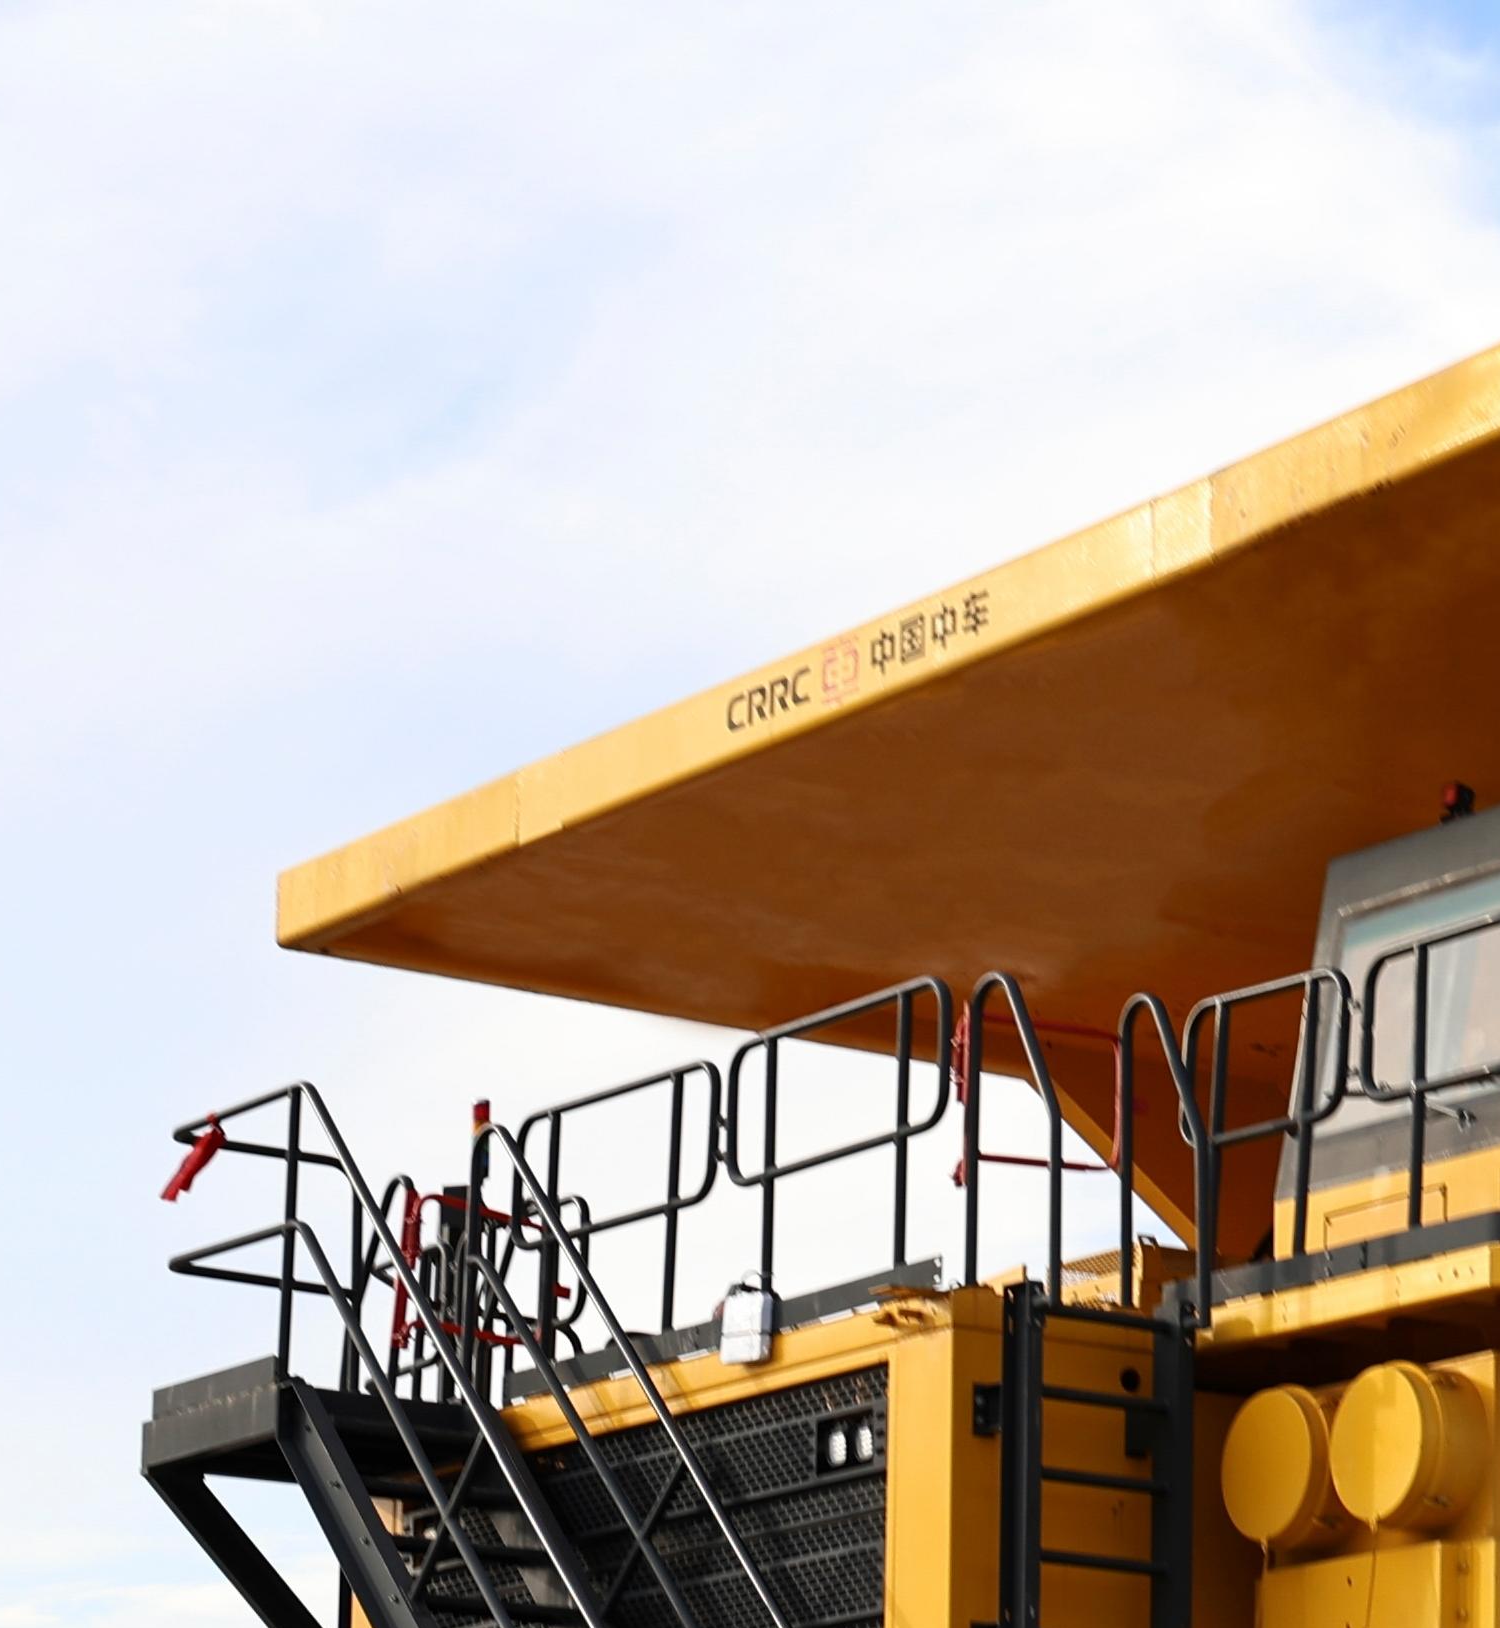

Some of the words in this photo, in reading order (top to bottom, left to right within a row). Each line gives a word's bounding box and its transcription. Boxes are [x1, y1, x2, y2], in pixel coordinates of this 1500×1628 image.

[726, 666, 811, 733] CRRC
[870, 589, 990, 676] 中国中车
